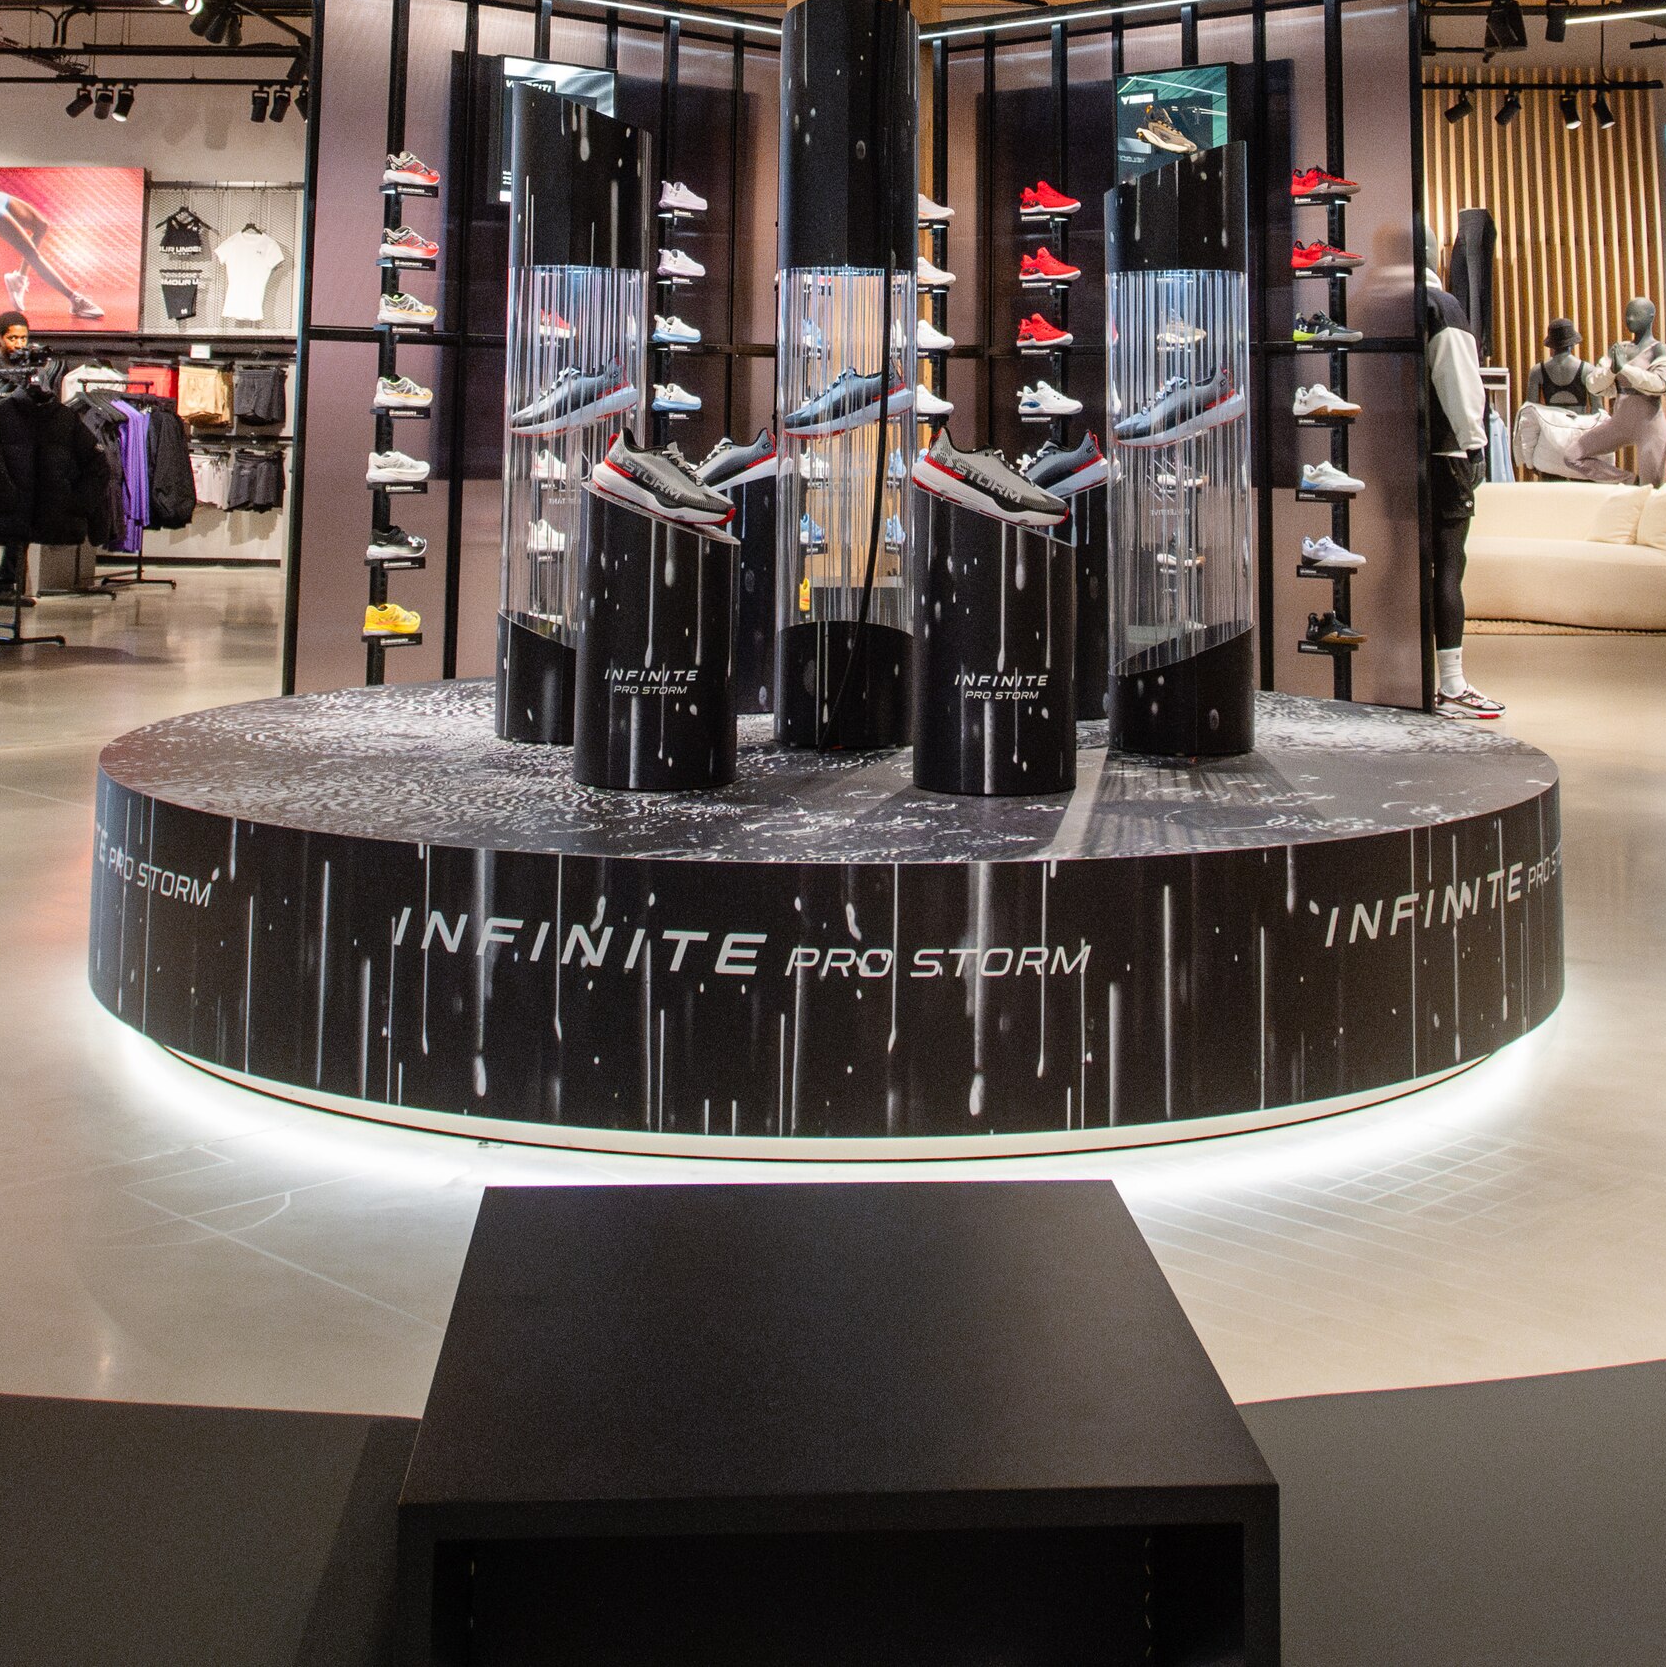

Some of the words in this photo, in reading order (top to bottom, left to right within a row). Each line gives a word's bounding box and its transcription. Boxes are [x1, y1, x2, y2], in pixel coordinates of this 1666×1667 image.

[623, 459, 684, 501] STORM
[953, 463, 1022, 504] STORM
[604, 668, 698, 682] INFINITE
[614, 685, 639, 693] PRO
[642, 685, 687, 694] STORM
[954, 674, 1048, 687] INFINITE
[965, 691, 992, 699] PRO
[995, 691, 1039, 700] STORM
[109, 847, 133, 881] PRO
[137, 863, 212, 907] STORM
[1325, 861, 1523, 947] INFINITE
[1527, 856, 1550, 893] PRO
[393, 907, 768, 975] INFINITE
[785, 947, 892, 978] PRO
[910, 945, 1093, 978] STORM
